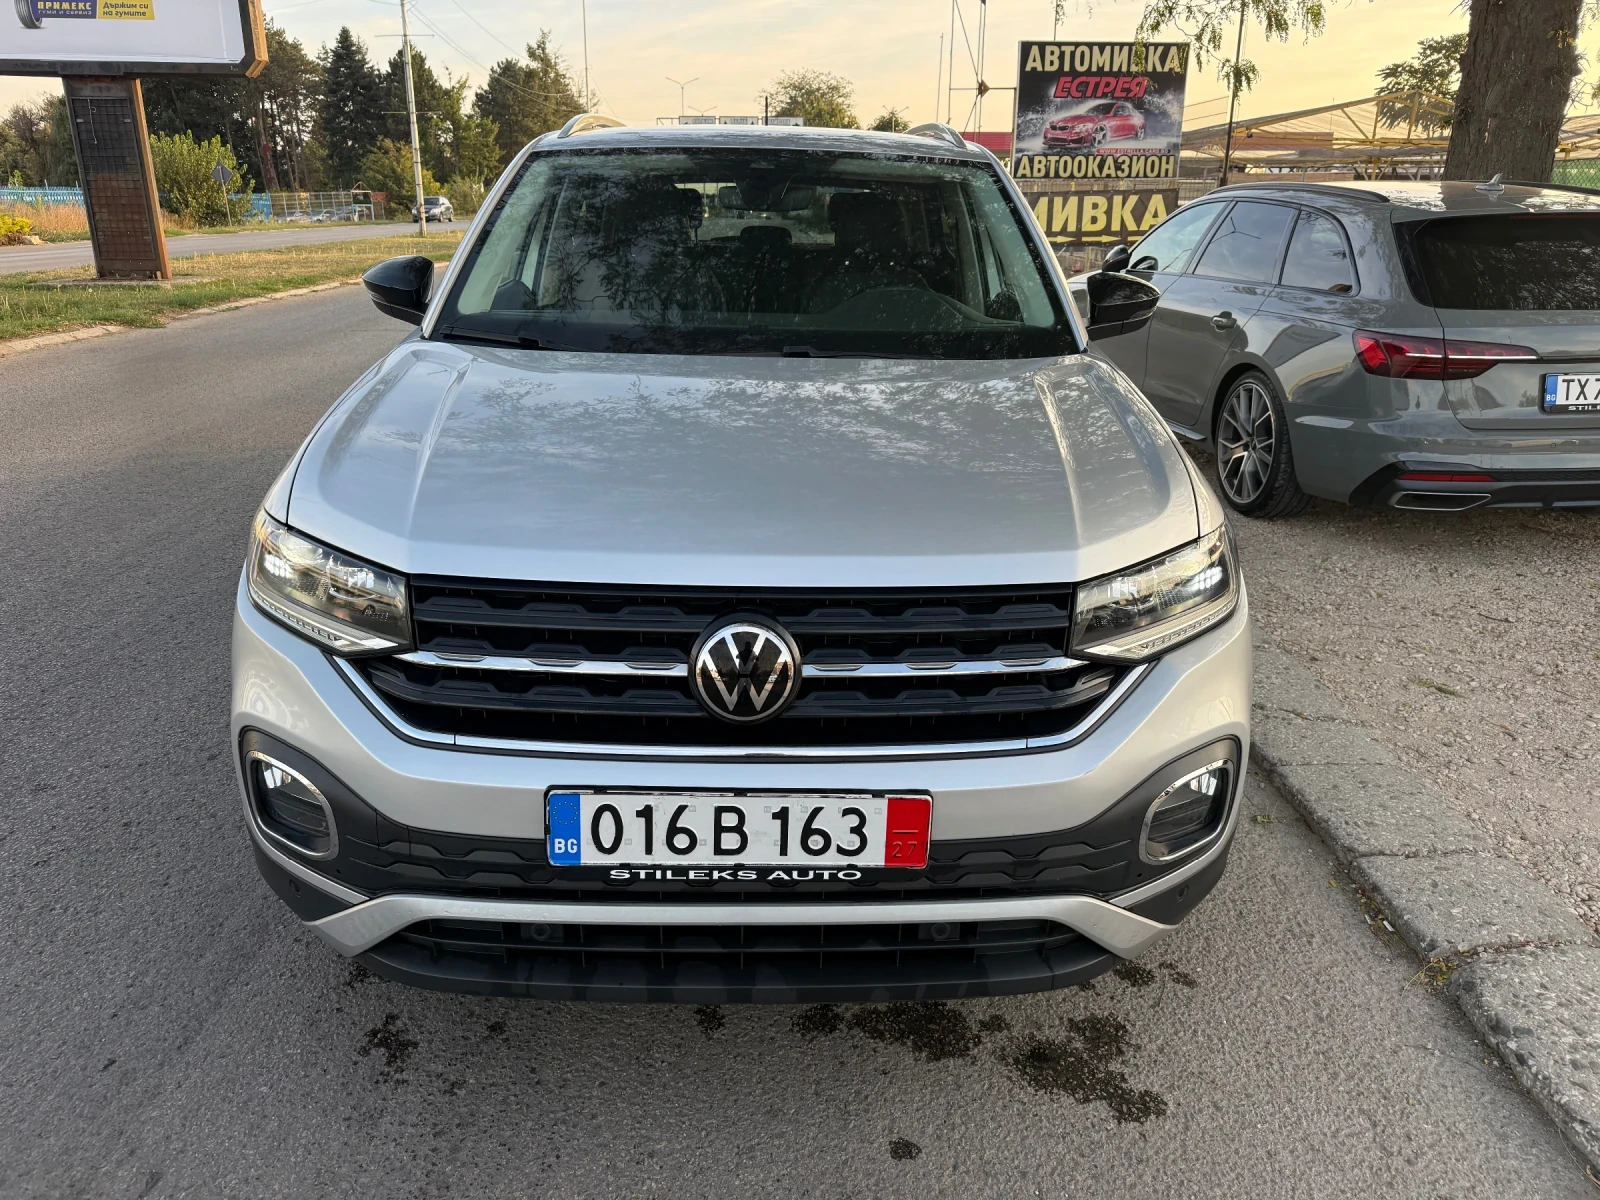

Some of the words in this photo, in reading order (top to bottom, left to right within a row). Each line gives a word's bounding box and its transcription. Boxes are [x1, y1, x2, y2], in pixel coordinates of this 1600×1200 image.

[37, 1, 92, 10] ПРИМЕКС
[103, 1, 137, 10] Държим
[115, 10, 147, 18] гумите
[1054, 76, 1148, 99] ЕСТРЕЯ
[1016, 155, 1175, 178] АВТООКАЗИОН
[554, 838, 578, 854] BG
[891, 841, 918, 858] 27
[609, 869, 758, 880] STILEKS
[766, 870, 862, 880] AUTO
